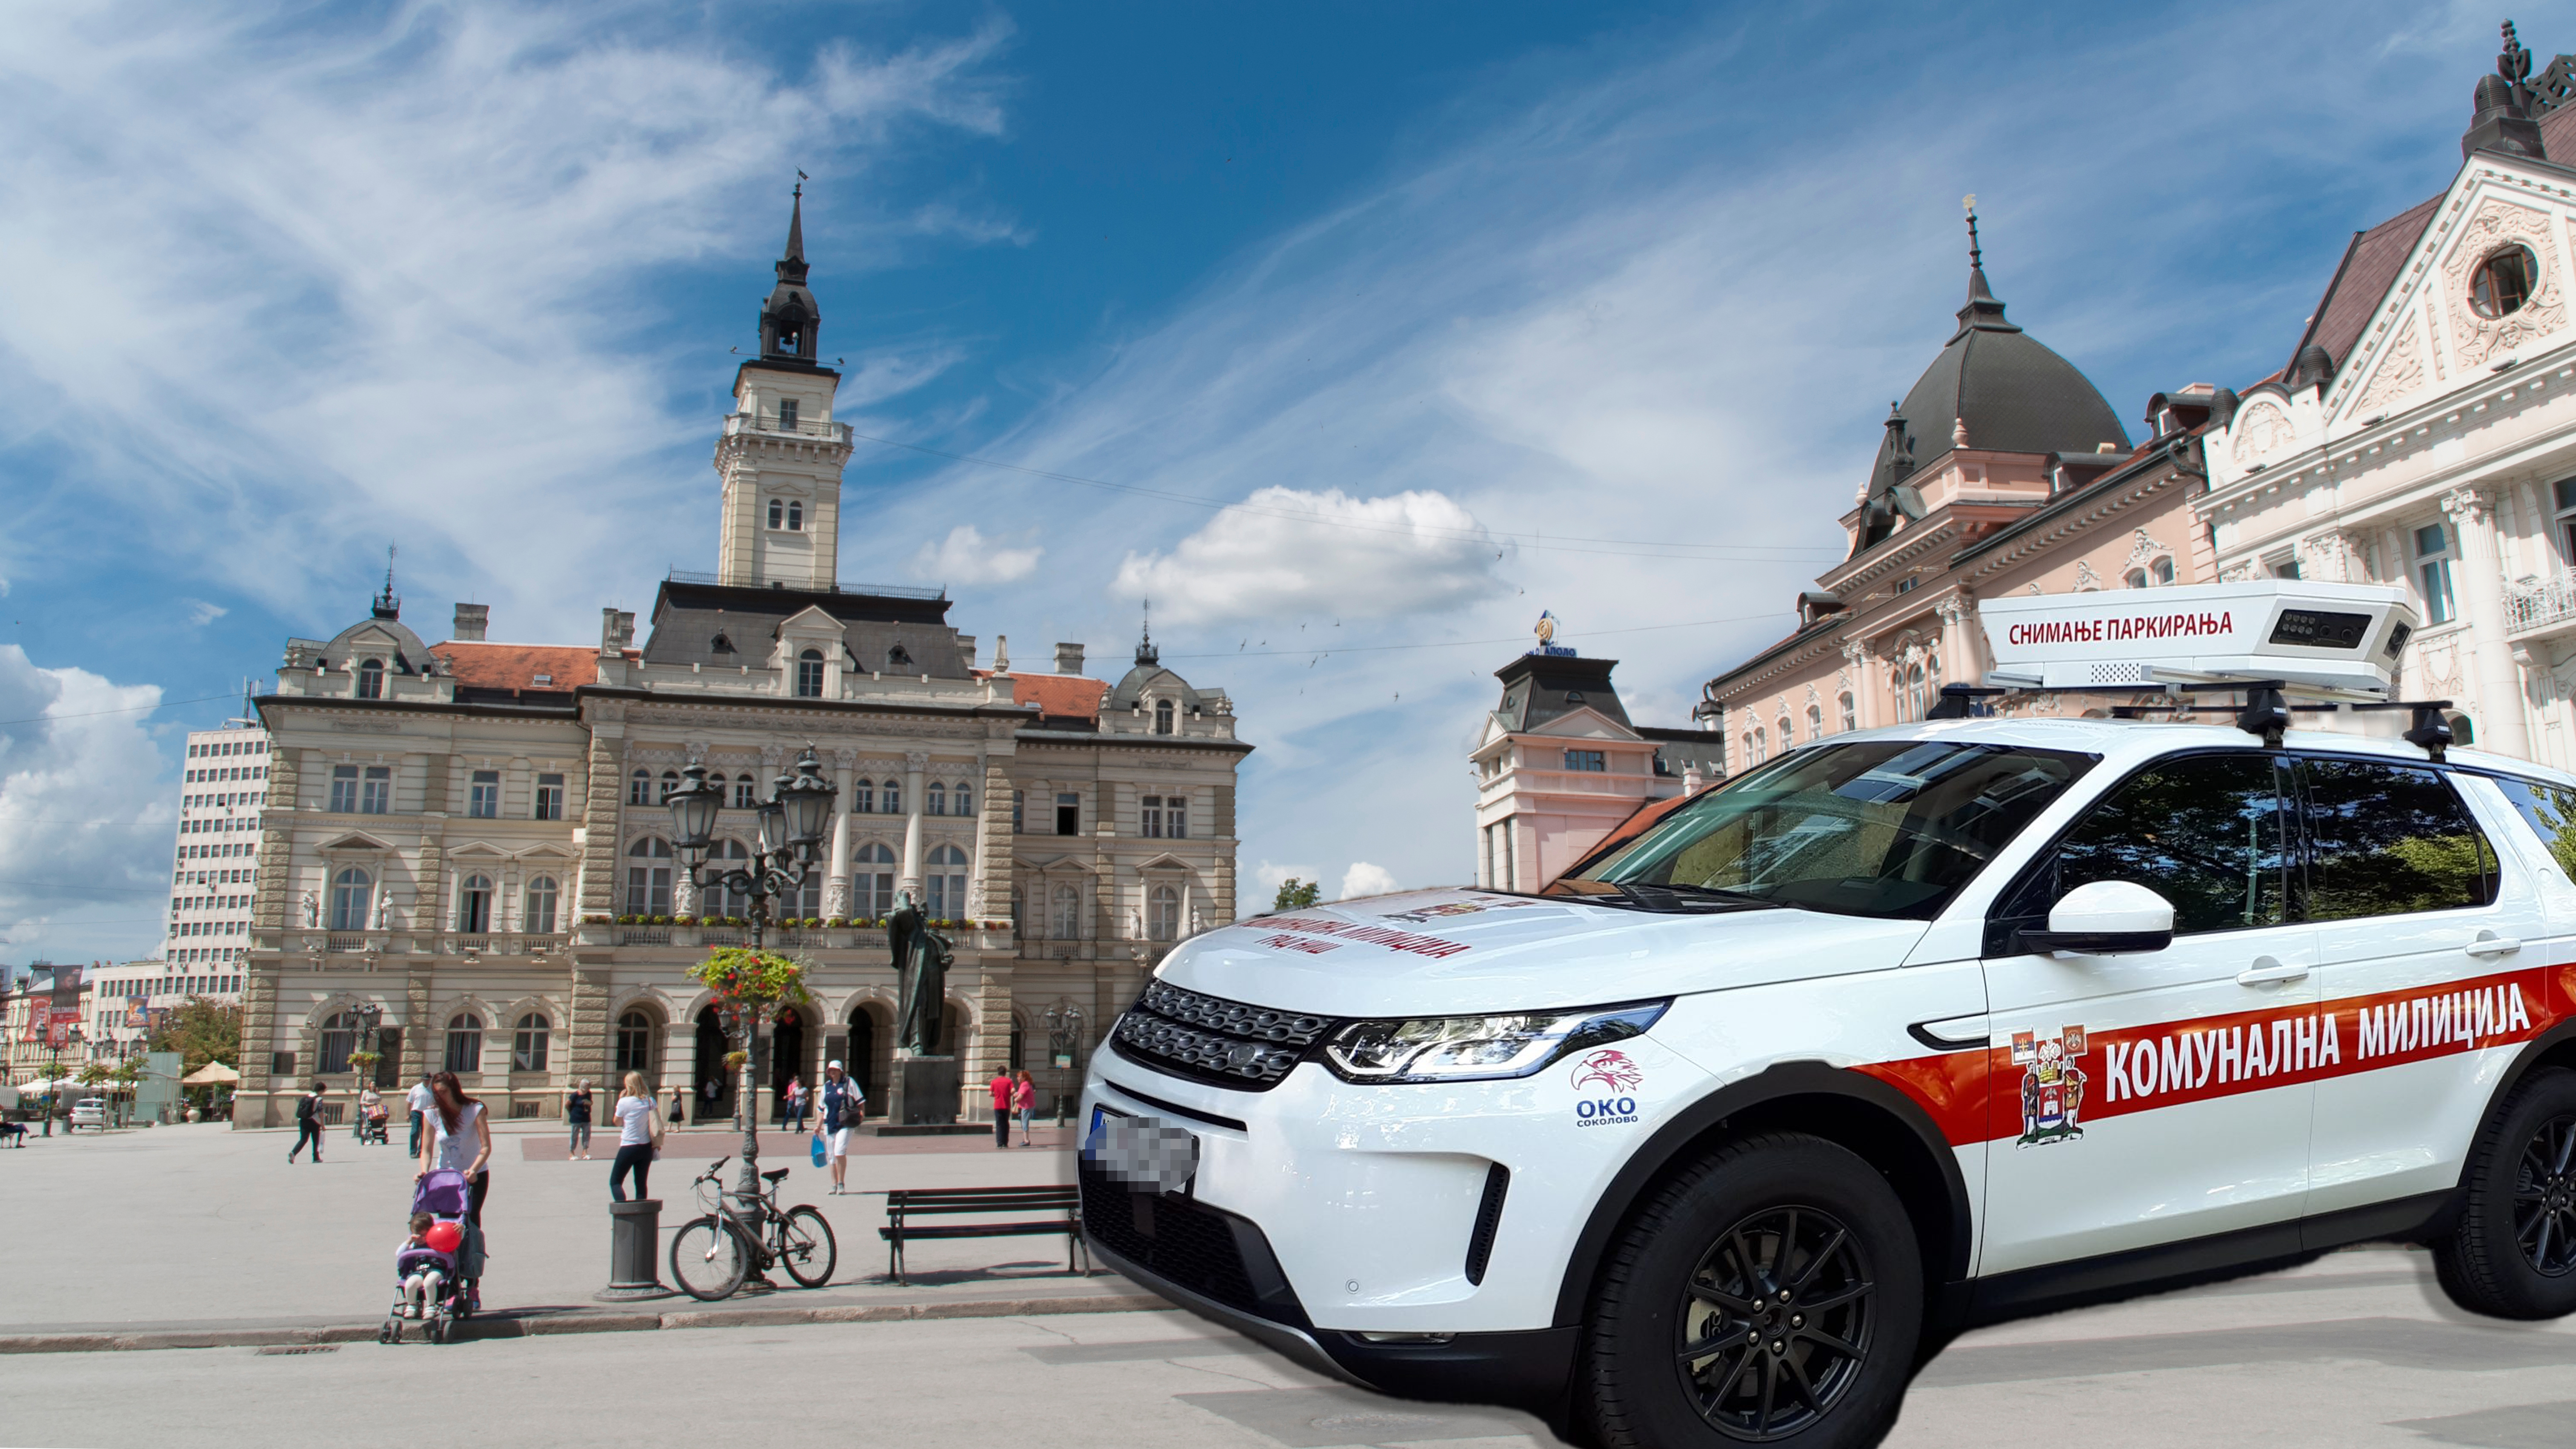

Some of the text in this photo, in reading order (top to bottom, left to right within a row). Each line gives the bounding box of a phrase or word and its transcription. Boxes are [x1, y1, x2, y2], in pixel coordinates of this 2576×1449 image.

[2009, 611, 2233, 645] СНИМАЊЕ ПАРКИРАЊА
[1544, 647, 1575, 657] АПОЛО
[1332, 926, 1472, 959] МИЛИЦИЈА
[2106, 982, 2531, 1102] КОМУНАЛНА МИЛИЦИЈА
[1577, 1097, 1635, 1118] ОКО
